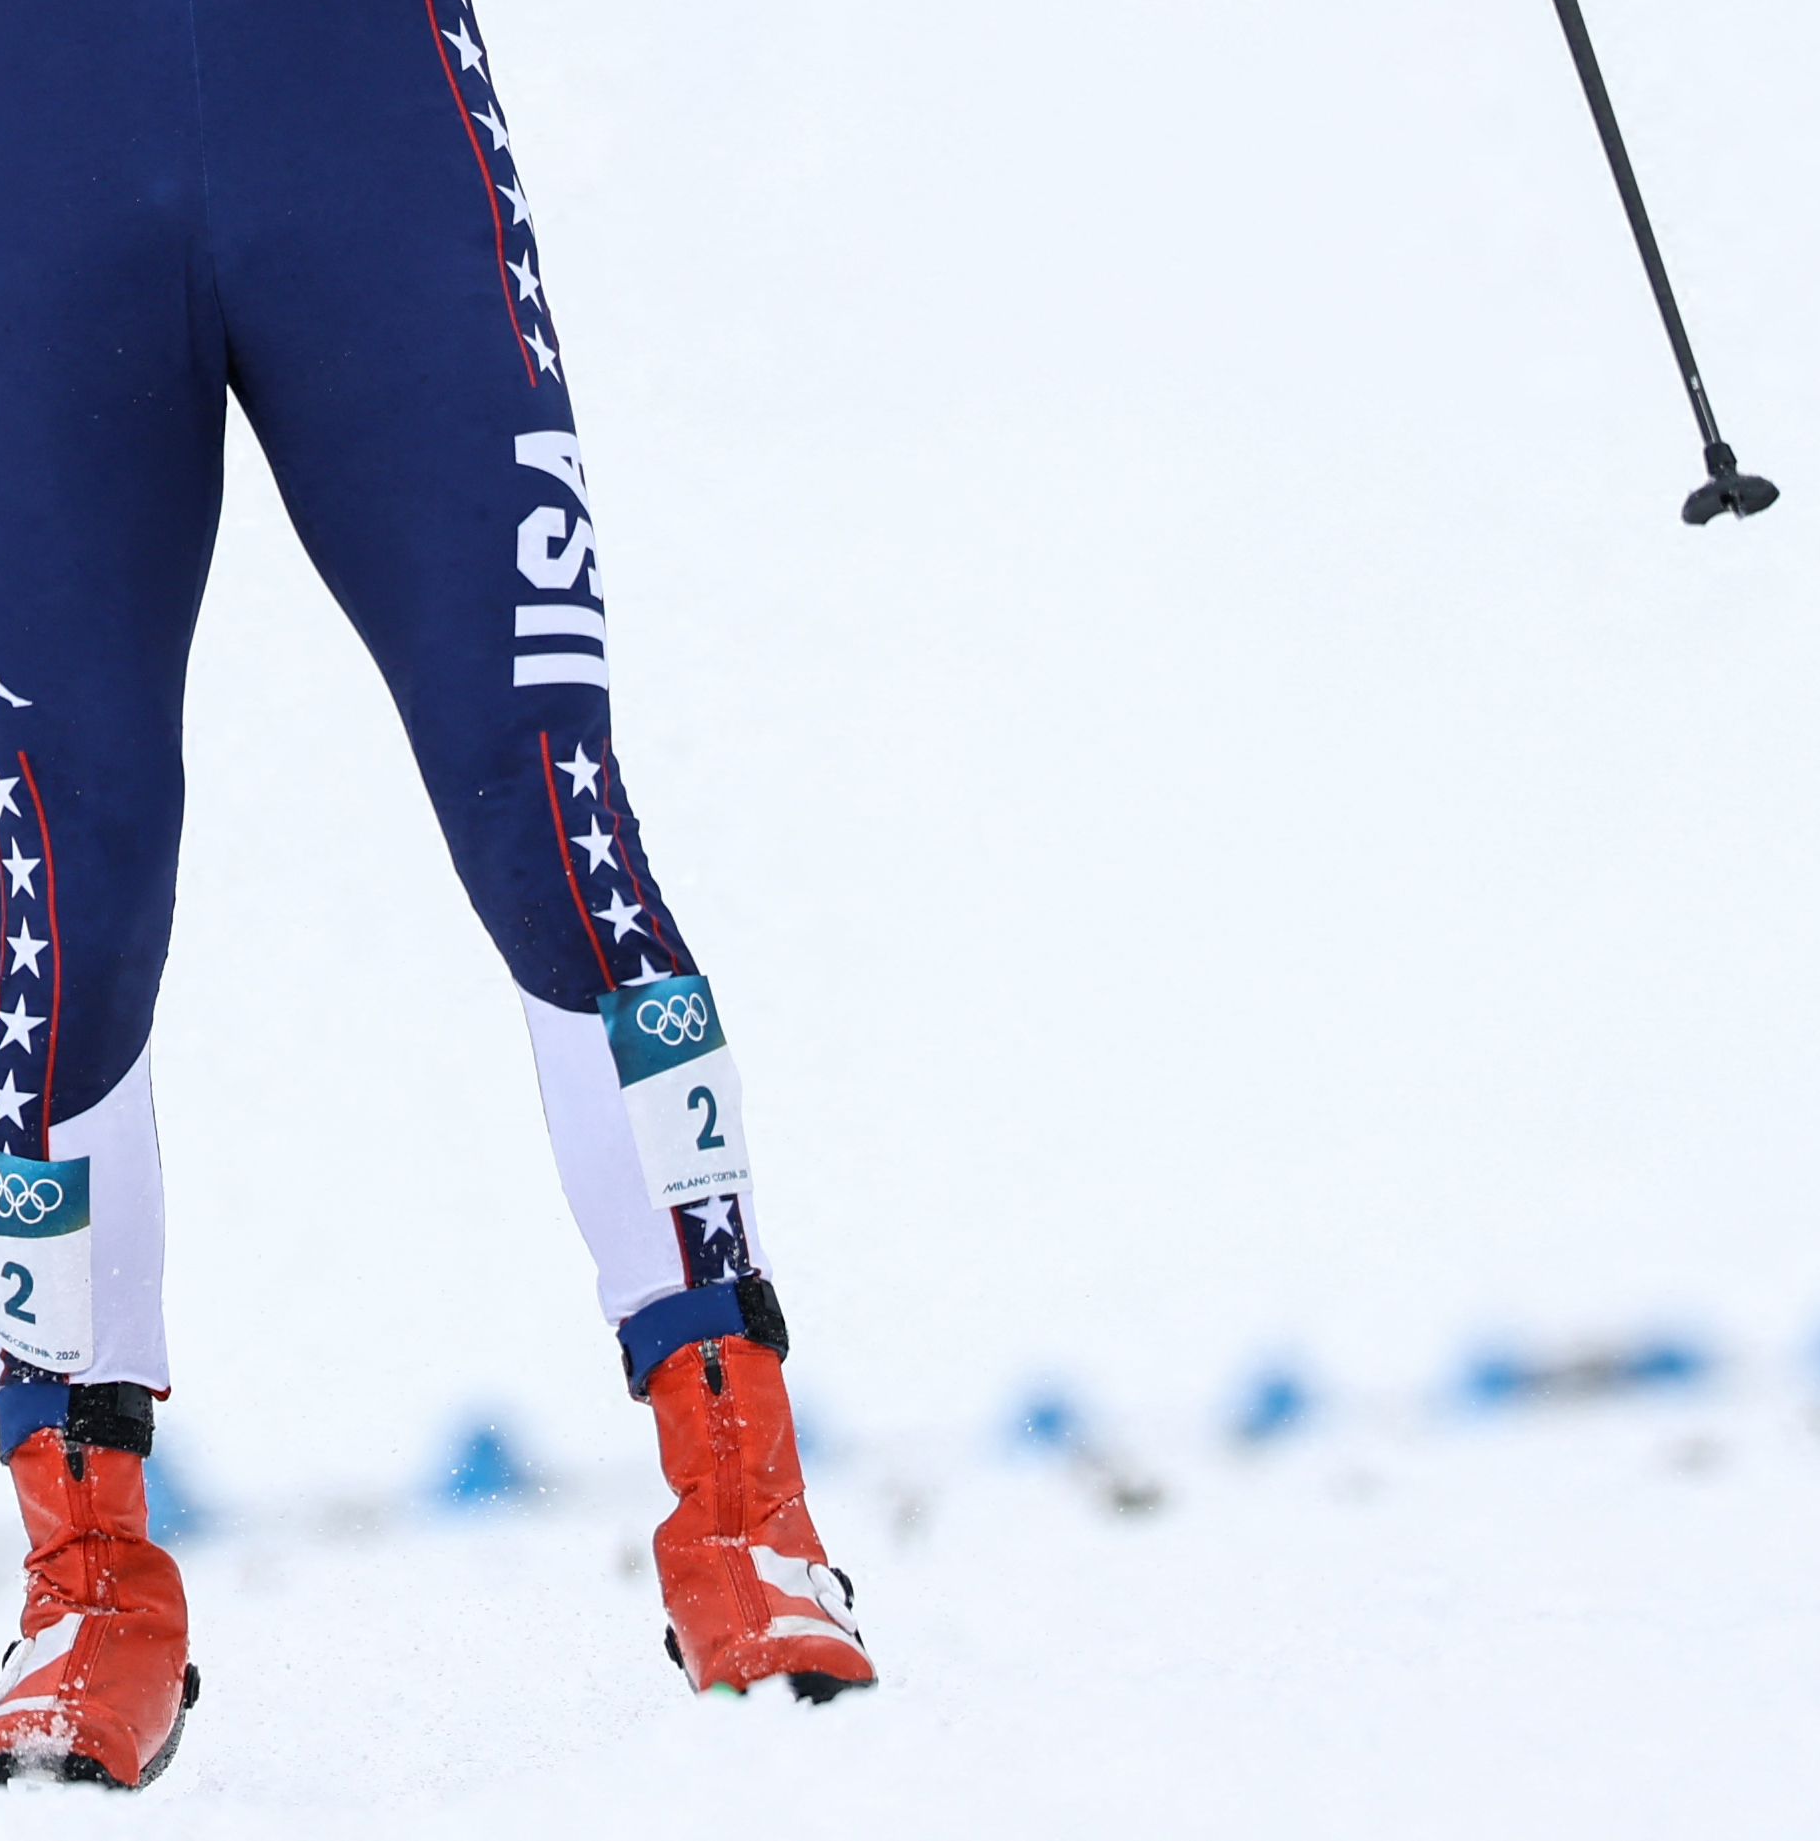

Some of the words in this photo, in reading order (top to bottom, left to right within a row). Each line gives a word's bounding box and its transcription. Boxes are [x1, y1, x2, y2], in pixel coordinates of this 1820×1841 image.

[513, 431, 609, 690] USA
[687, 1085, 725, 1151] 2
[663, 1175, 711, 1194] MILANO
[1, 1261, 36, 1325] 2
[55, 1350, 80, 1361] 2026
